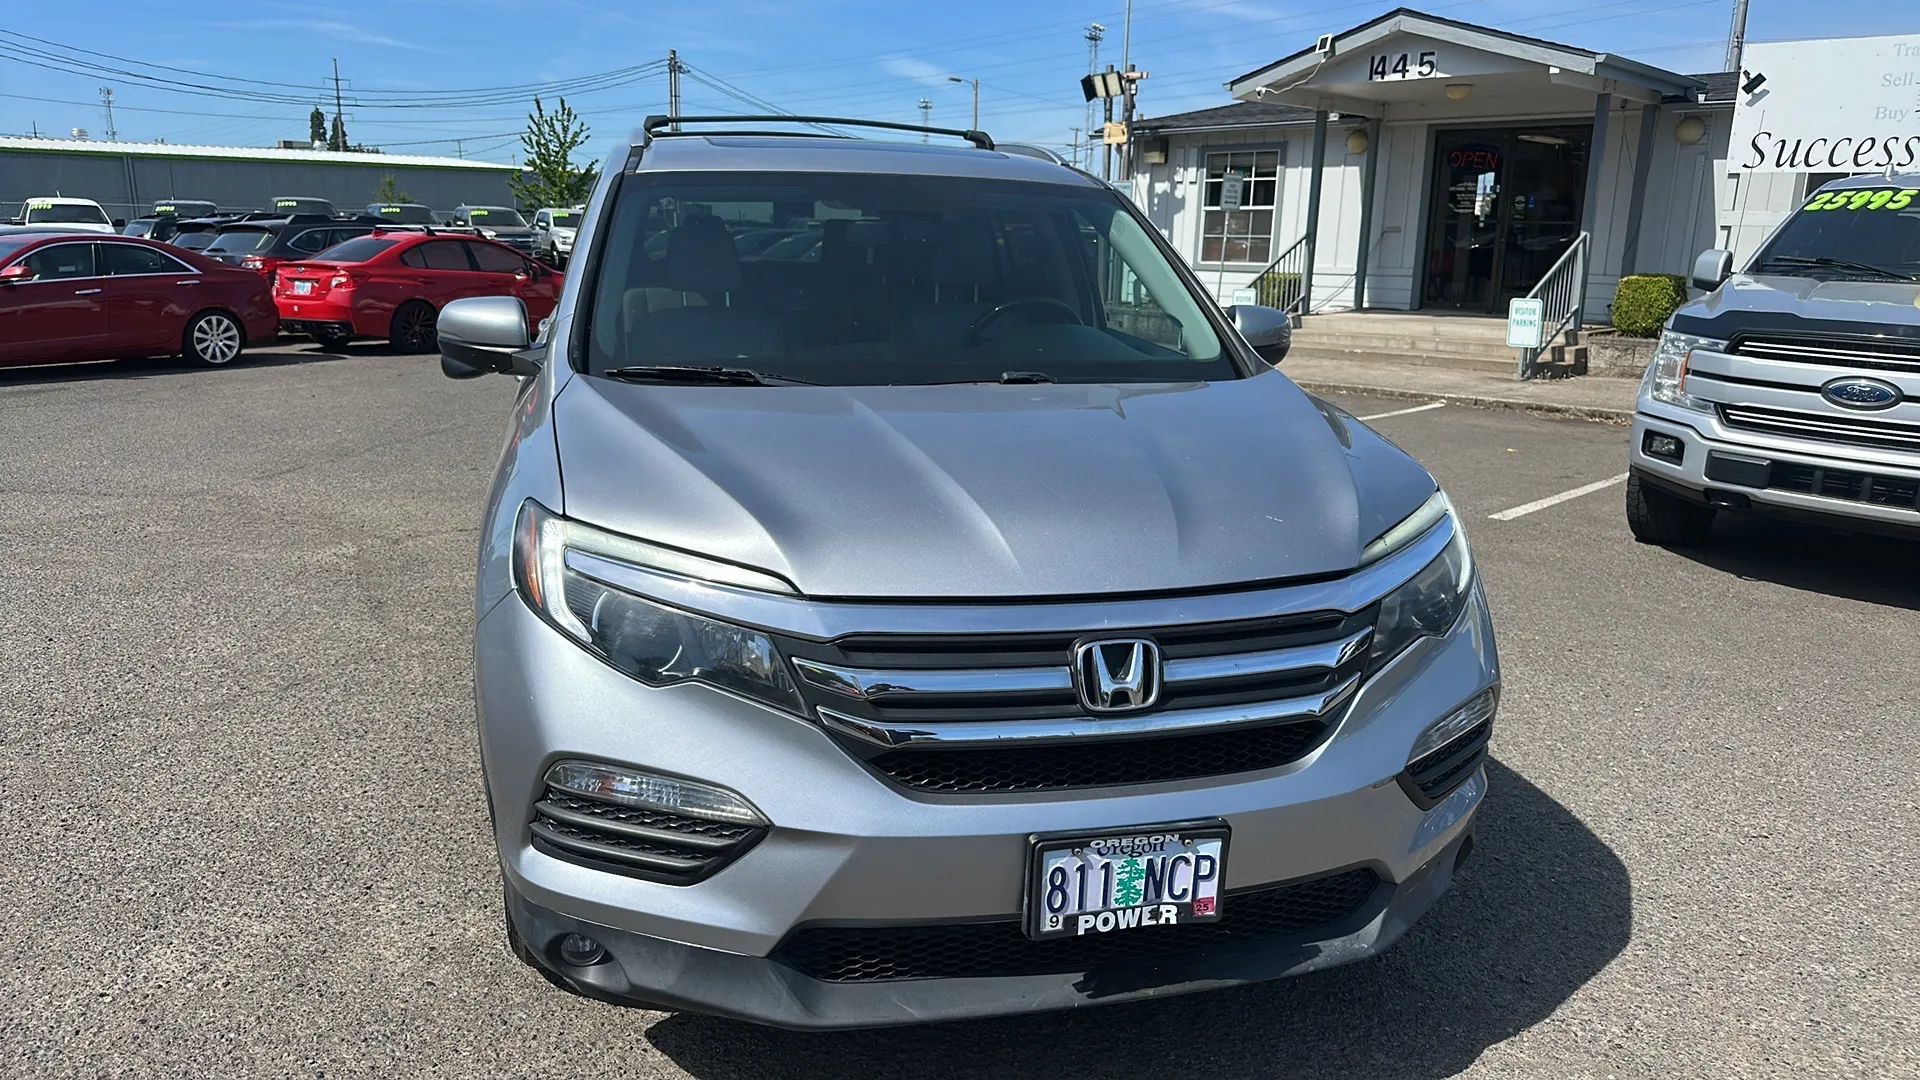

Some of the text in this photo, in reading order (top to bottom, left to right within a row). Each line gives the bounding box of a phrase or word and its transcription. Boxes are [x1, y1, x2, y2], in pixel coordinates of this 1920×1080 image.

[1368, 51, 1436, 81] 1445
[1881, 72, 1914, 88] Sell
[1875, 106, 1910, 123] Buy
[1742, 131, 1920, 169] Success
[1450, 152, 1498, 168] OPEN
[1804, 189, 1919, 213] 25995
[1515, 307, 1537, 317] VISITOR
[1512, 318, 1537, 328] PARKING
[1090, 834, 1180, 849] OREGON
[1046, 854, 1217, 914] 811 NCP
[1195, 904, 1210, 912] 25
[1049, 914, 1060, 929] 9
[1077, 904, 1178, 936] POWER
